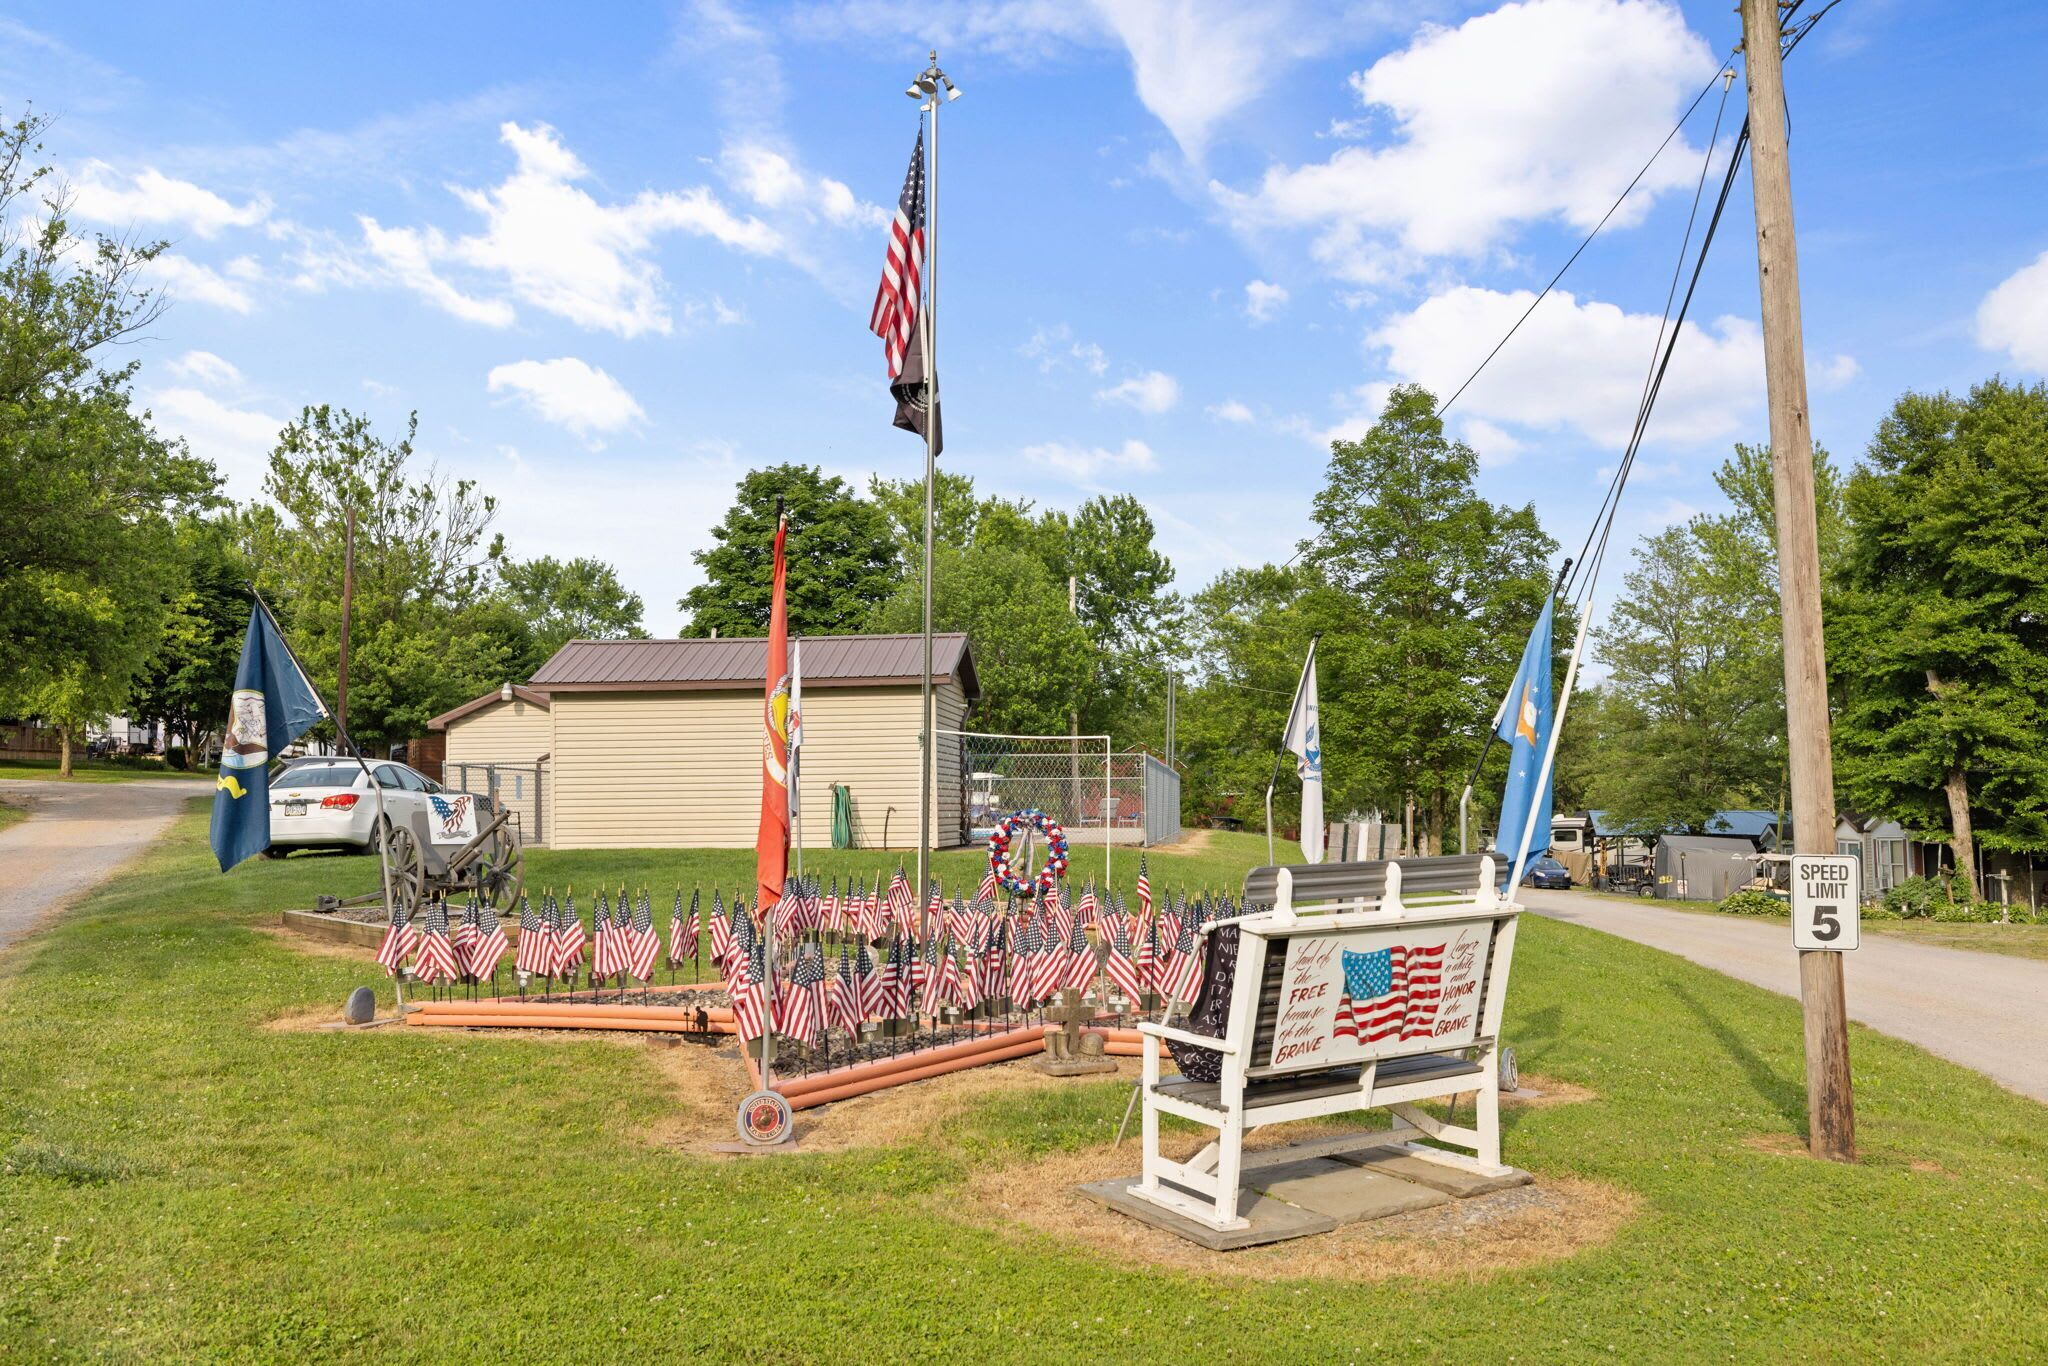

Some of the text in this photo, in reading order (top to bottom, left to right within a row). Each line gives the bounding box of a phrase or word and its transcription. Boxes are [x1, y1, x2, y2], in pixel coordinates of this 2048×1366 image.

[1800, 864, 1848, 881] SPEED
[1807, 882, 1848, 899] LIMIT
[1812, 906, 1841, 941] 5
[1294, 966, 1321, 985] the
[1450, 970, 1470, 983] and
[1289, 983, 1328, 1004] FREE
[1441, 980, 1476, 1002] HONOR
[1281, 1006, 1327, 1026] because
[1444, 1000, 1461, 1015] the
[1279, 1021, 1318, 1044] of the
[1435, 1015, 1472, 1036] BRAVE
[1275, 1036, 1324, 1064] BRAVE
